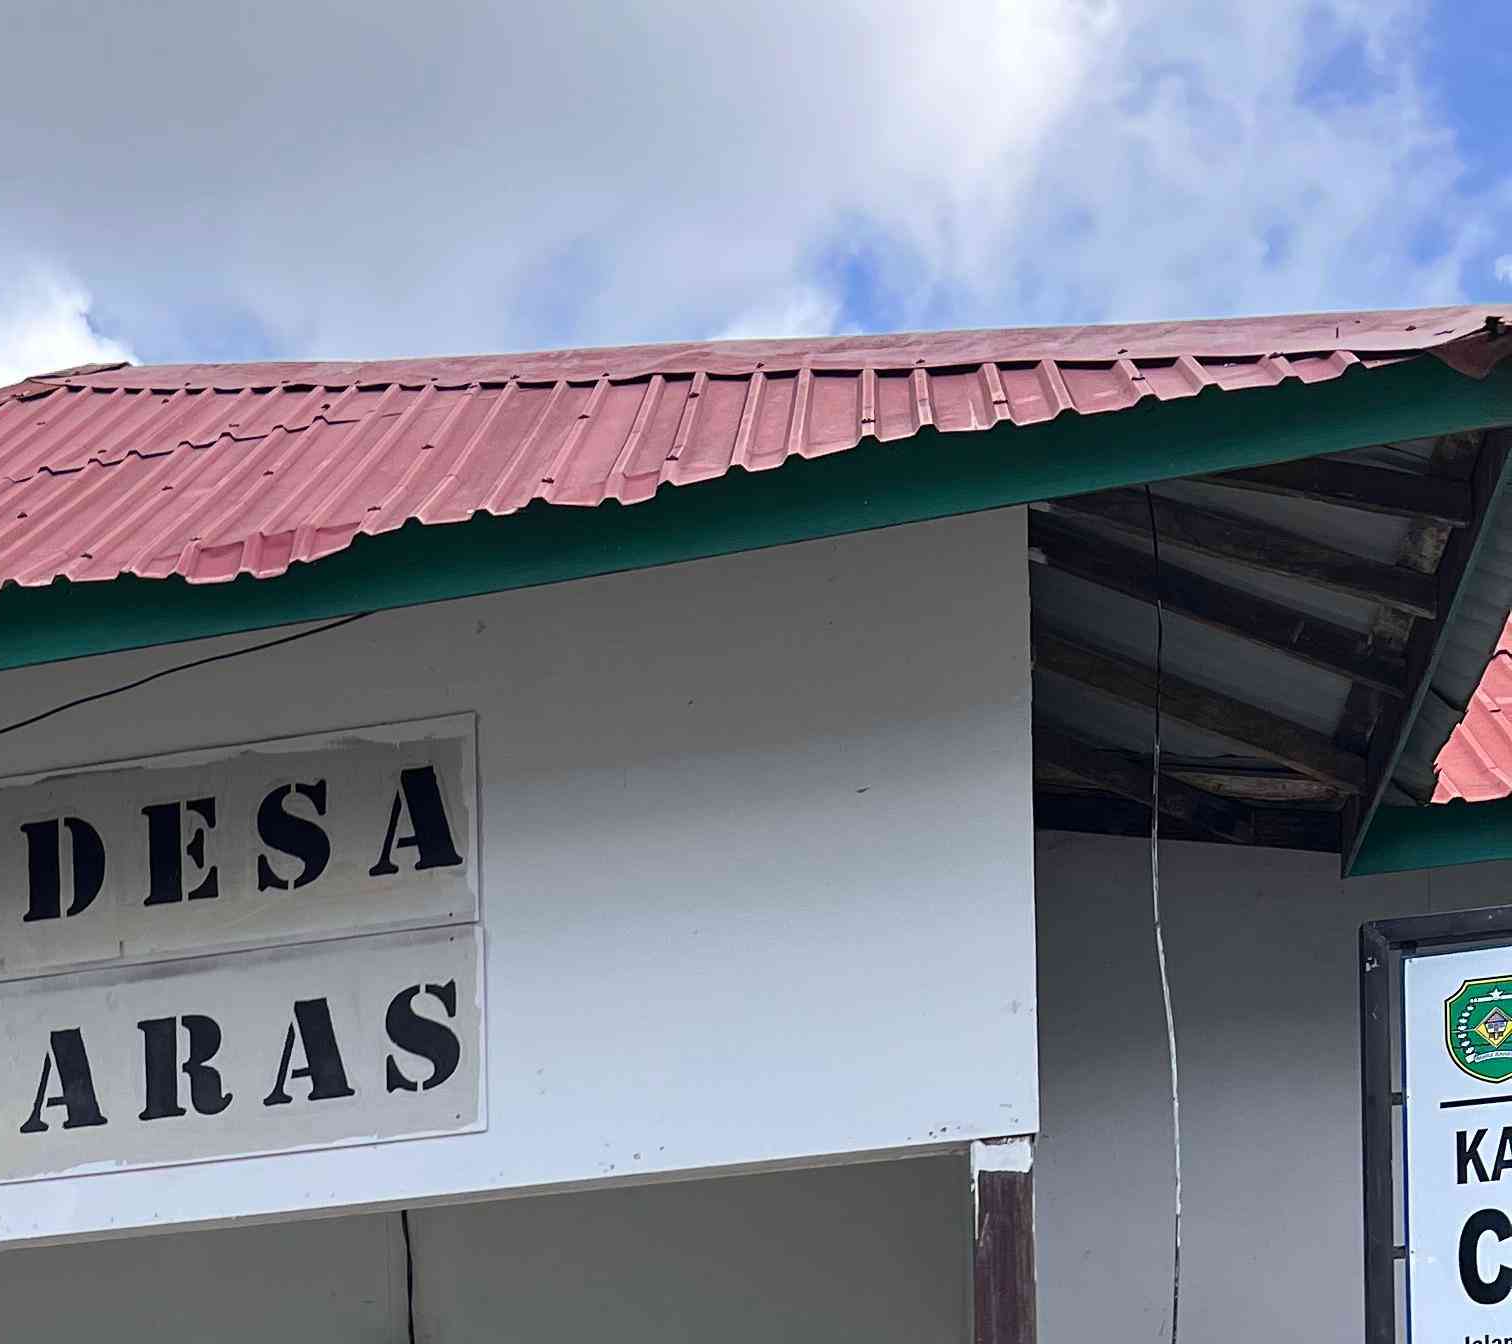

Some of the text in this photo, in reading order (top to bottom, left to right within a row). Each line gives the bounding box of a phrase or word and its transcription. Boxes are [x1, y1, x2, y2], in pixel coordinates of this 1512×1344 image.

[19, 765, 463, 923] DESA
[1456, 1126, 1512, 1185] KA
[1458, 1208, 1512, 1305] C
